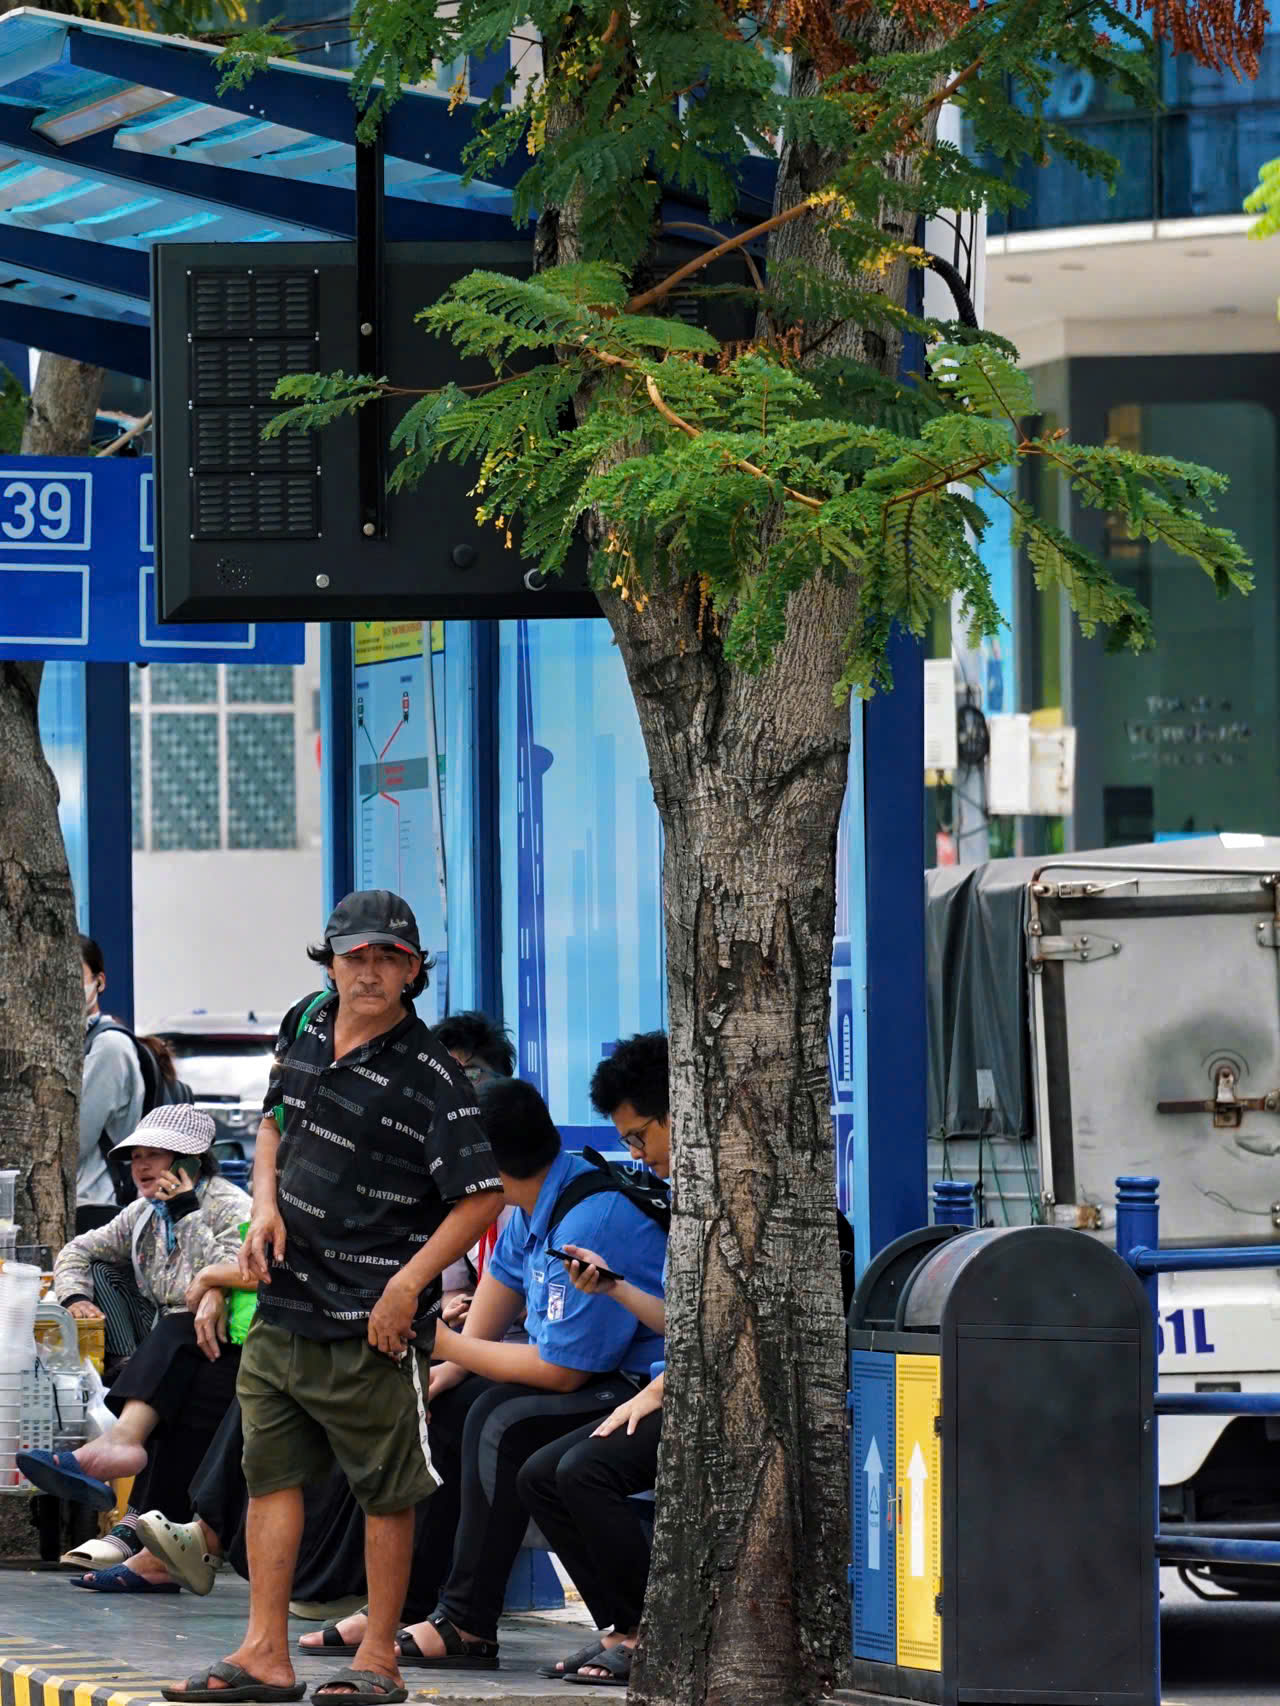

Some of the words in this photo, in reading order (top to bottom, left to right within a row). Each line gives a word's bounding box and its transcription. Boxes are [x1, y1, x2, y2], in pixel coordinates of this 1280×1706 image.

[1, 481, 72, 540] 39
[417, 1052, 429, 1063] 69
[447, 1111, 458, 1121] 69
[381, 1116, 393, 1127] 69
[395, 1121, 426, 1144] DAYDR
[309, 1123, 356, 1152] DAYDREAMS
[356, 1184, 366, 1195] 69
[465, 1184, 477, 1194] 69
[324, 1249, 336, 1258] 69
[339, 1252, 400, 1266] DAYDREAMS
